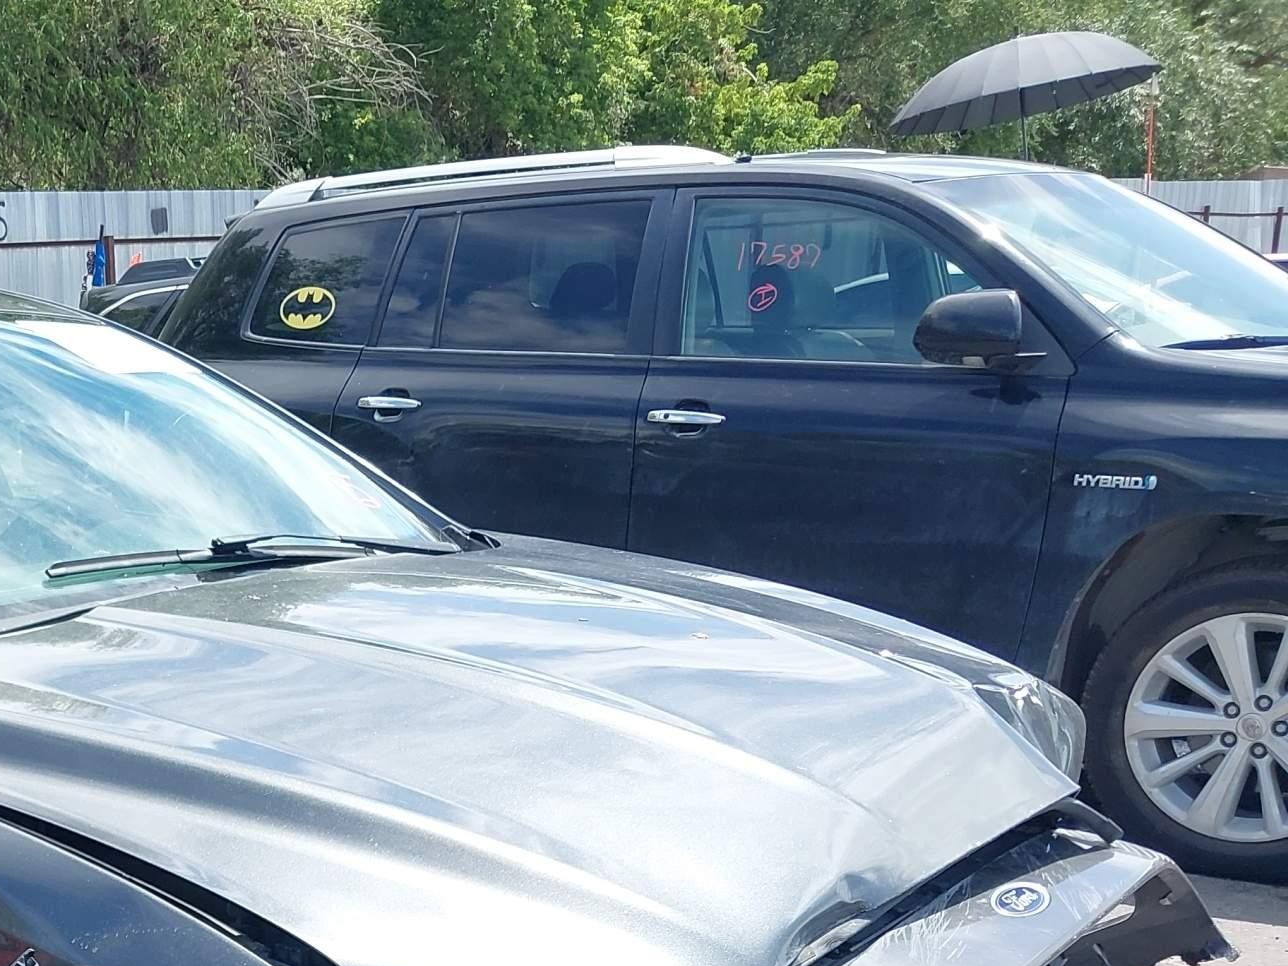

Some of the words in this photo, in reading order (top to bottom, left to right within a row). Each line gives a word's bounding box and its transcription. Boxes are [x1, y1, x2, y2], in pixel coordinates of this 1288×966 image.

[737, 241, 821, 271] 17587
[1073, 473, 1146, 489] HYBRID
[1002, 888, 1039, 911] Ford
